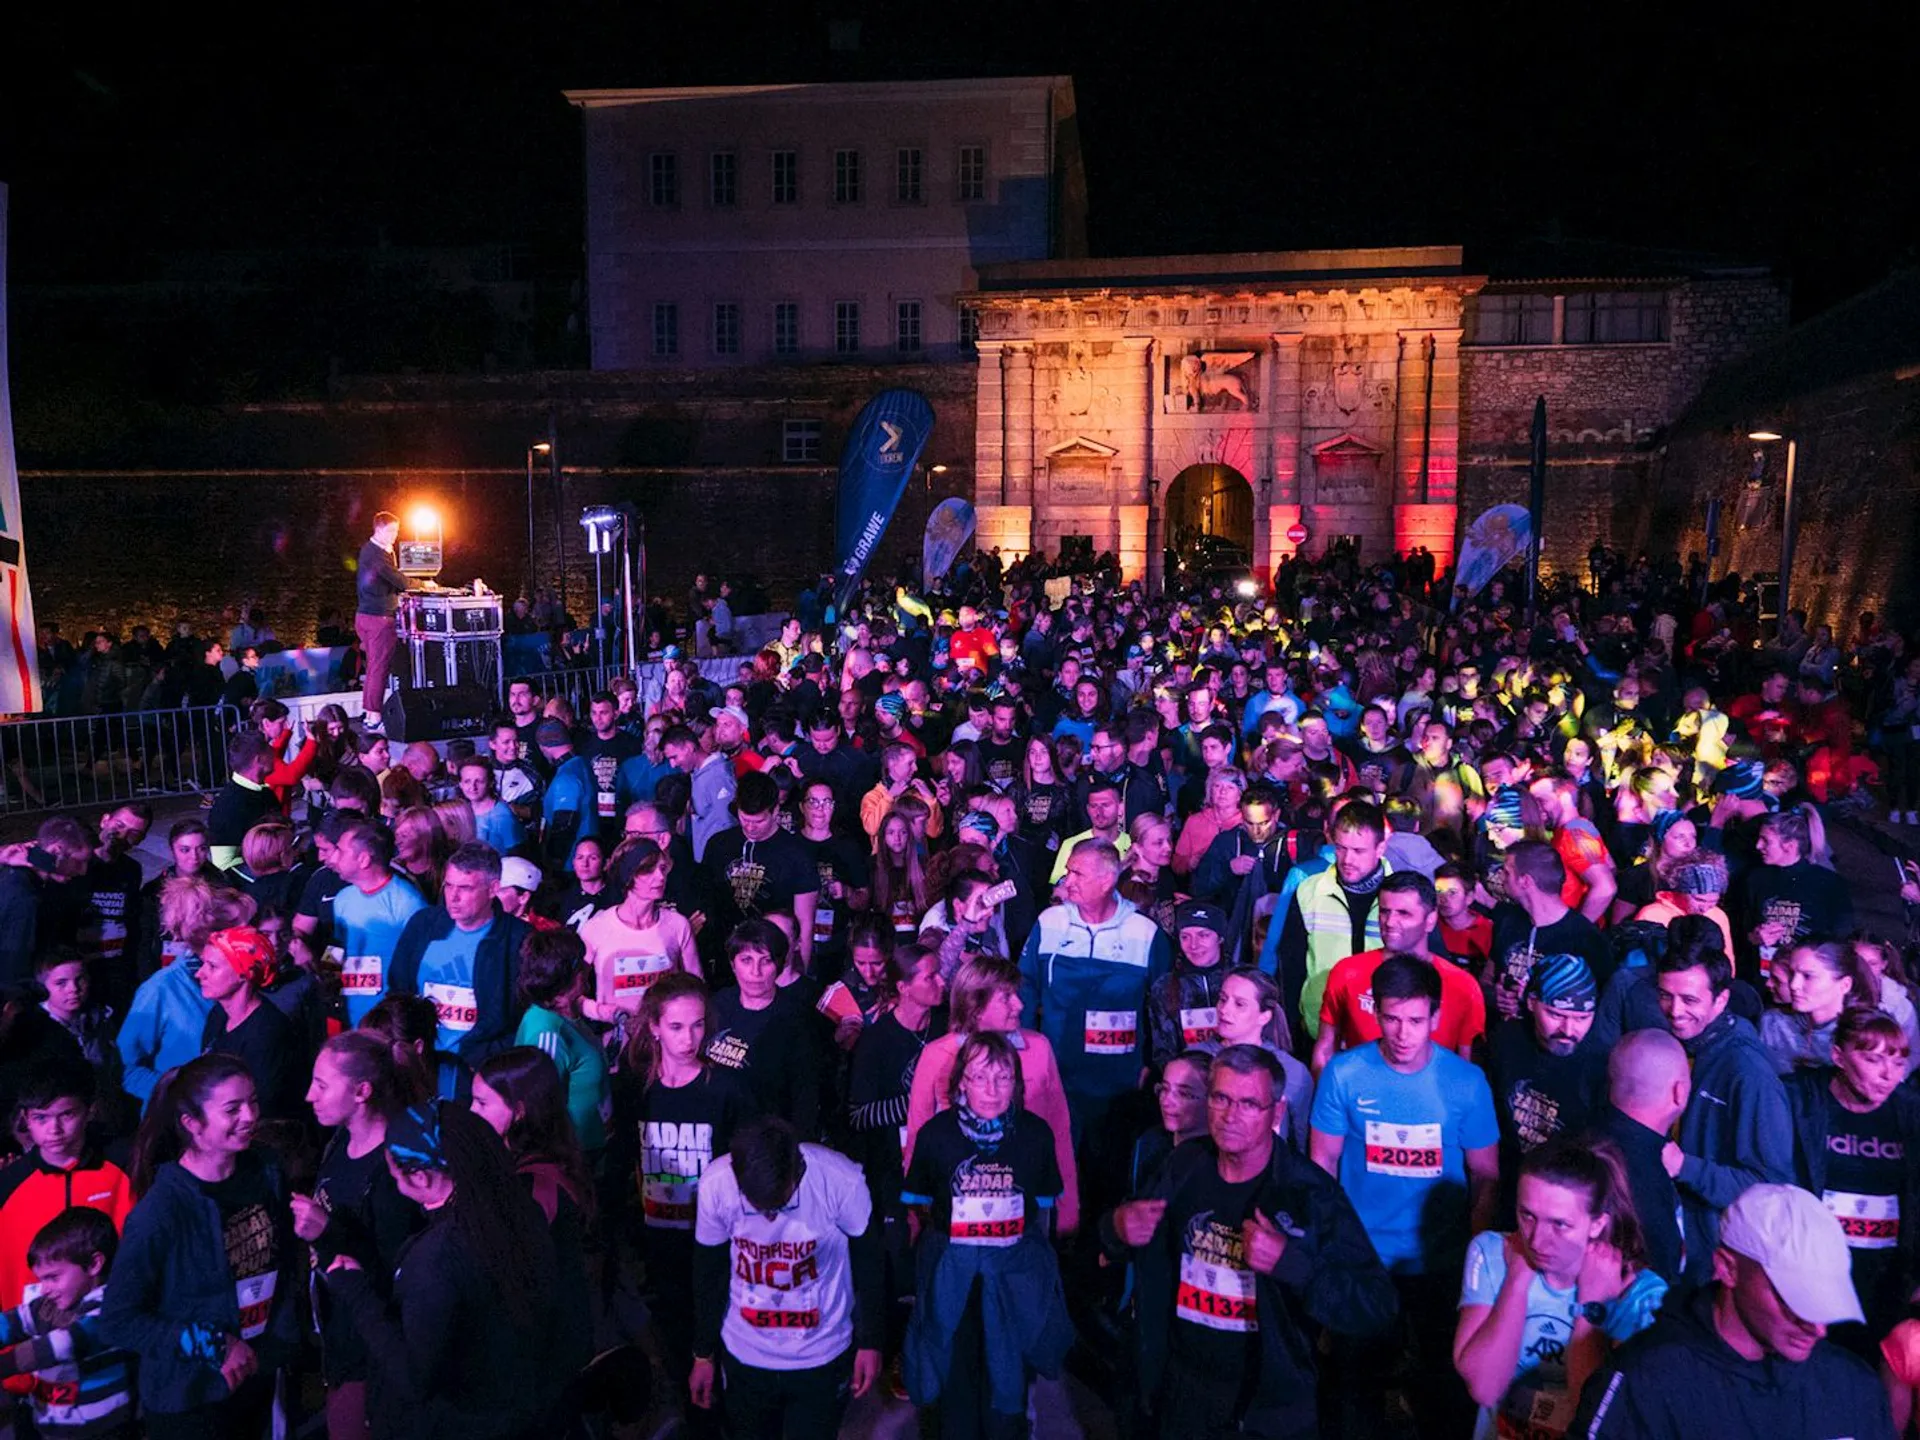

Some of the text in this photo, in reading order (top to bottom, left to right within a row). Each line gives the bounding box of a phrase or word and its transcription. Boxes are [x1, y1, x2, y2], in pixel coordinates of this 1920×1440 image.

[856, 510, 886, 561] GRAWE
[344, 973, 376, 987] 1173
[710, 1040, 746, 1061] ZADAR
[1382, 1147, 1436, 1166] 2028
[960, 1173, 1015, 1191] ZADAR
[1192, 1291, 1246, 1317] 1132
[757, 1312, 815, 1328] 5120
